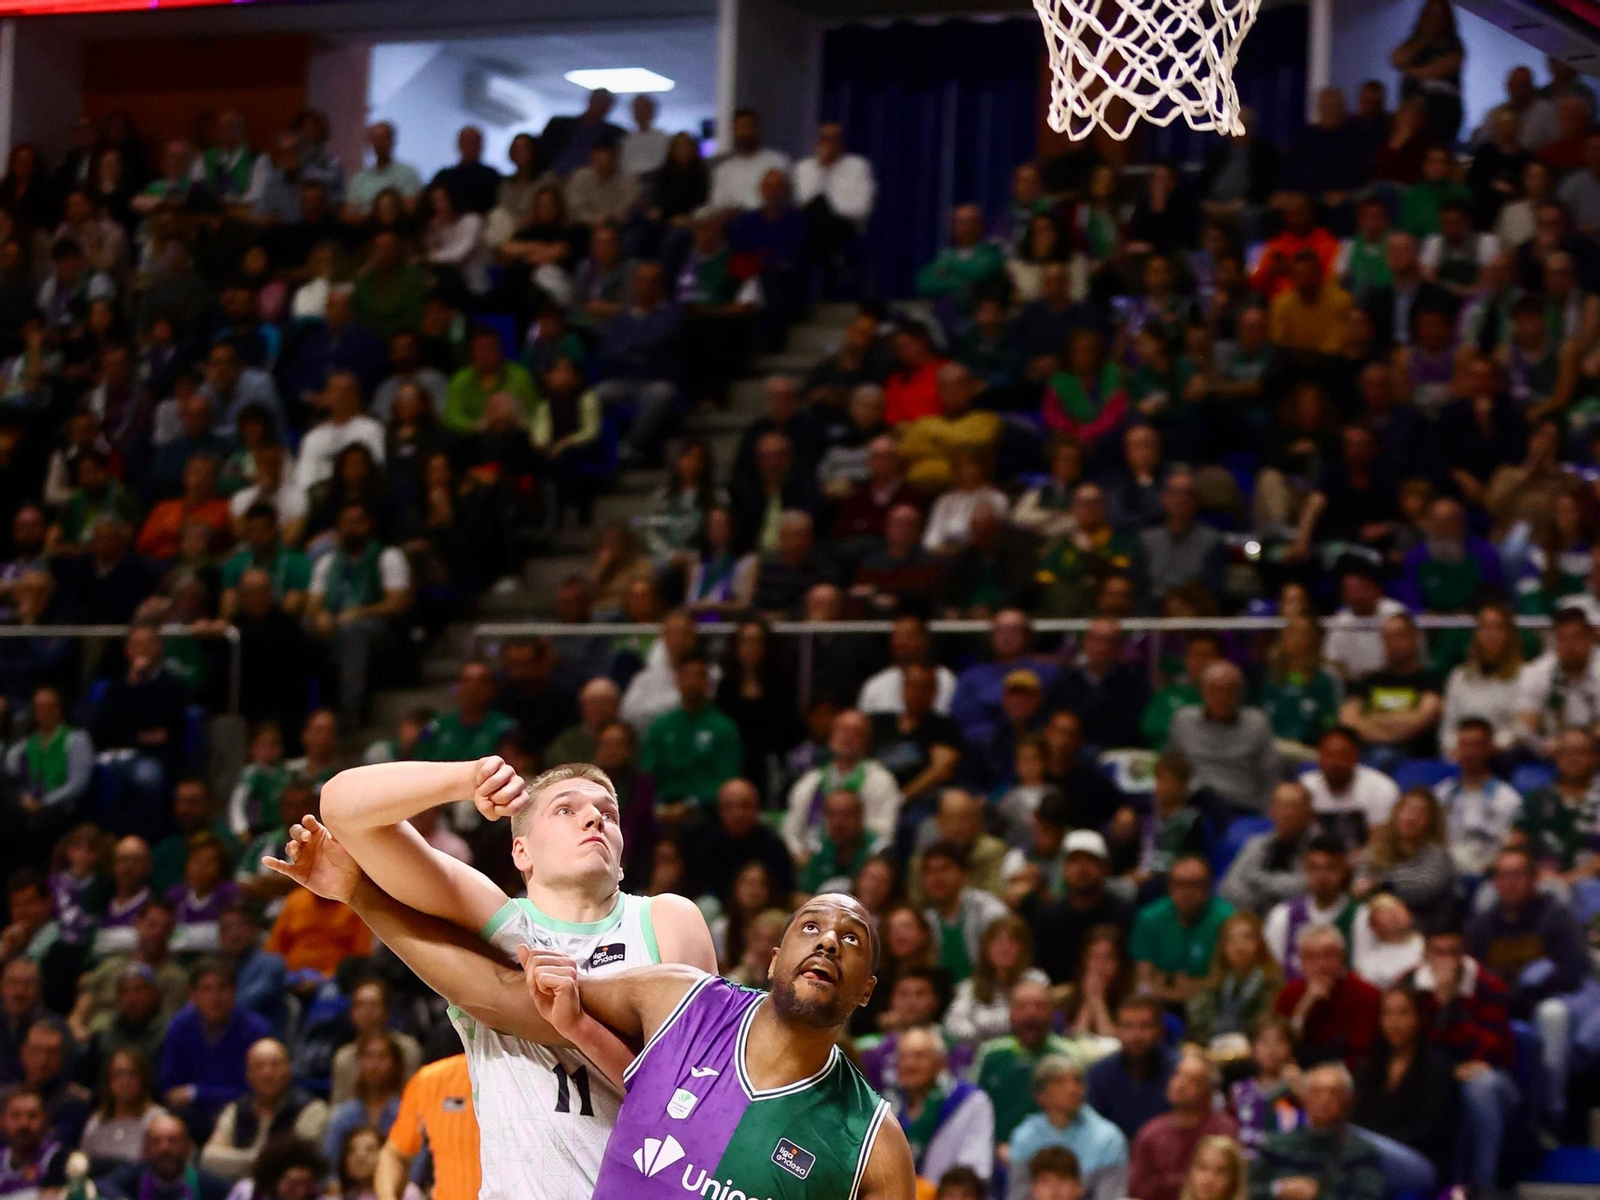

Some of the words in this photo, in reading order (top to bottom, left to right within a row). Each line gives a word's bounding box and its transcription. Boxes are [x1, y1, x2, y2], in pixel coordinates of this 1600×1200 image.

[592, 952, 606, 960] liga
[592, 954, 624, 966] endesa
[552, 1062, 594, 1117] 11
[779, 1146, 794, 1160] liga
[776, 1154, 806, 1176] endesa
